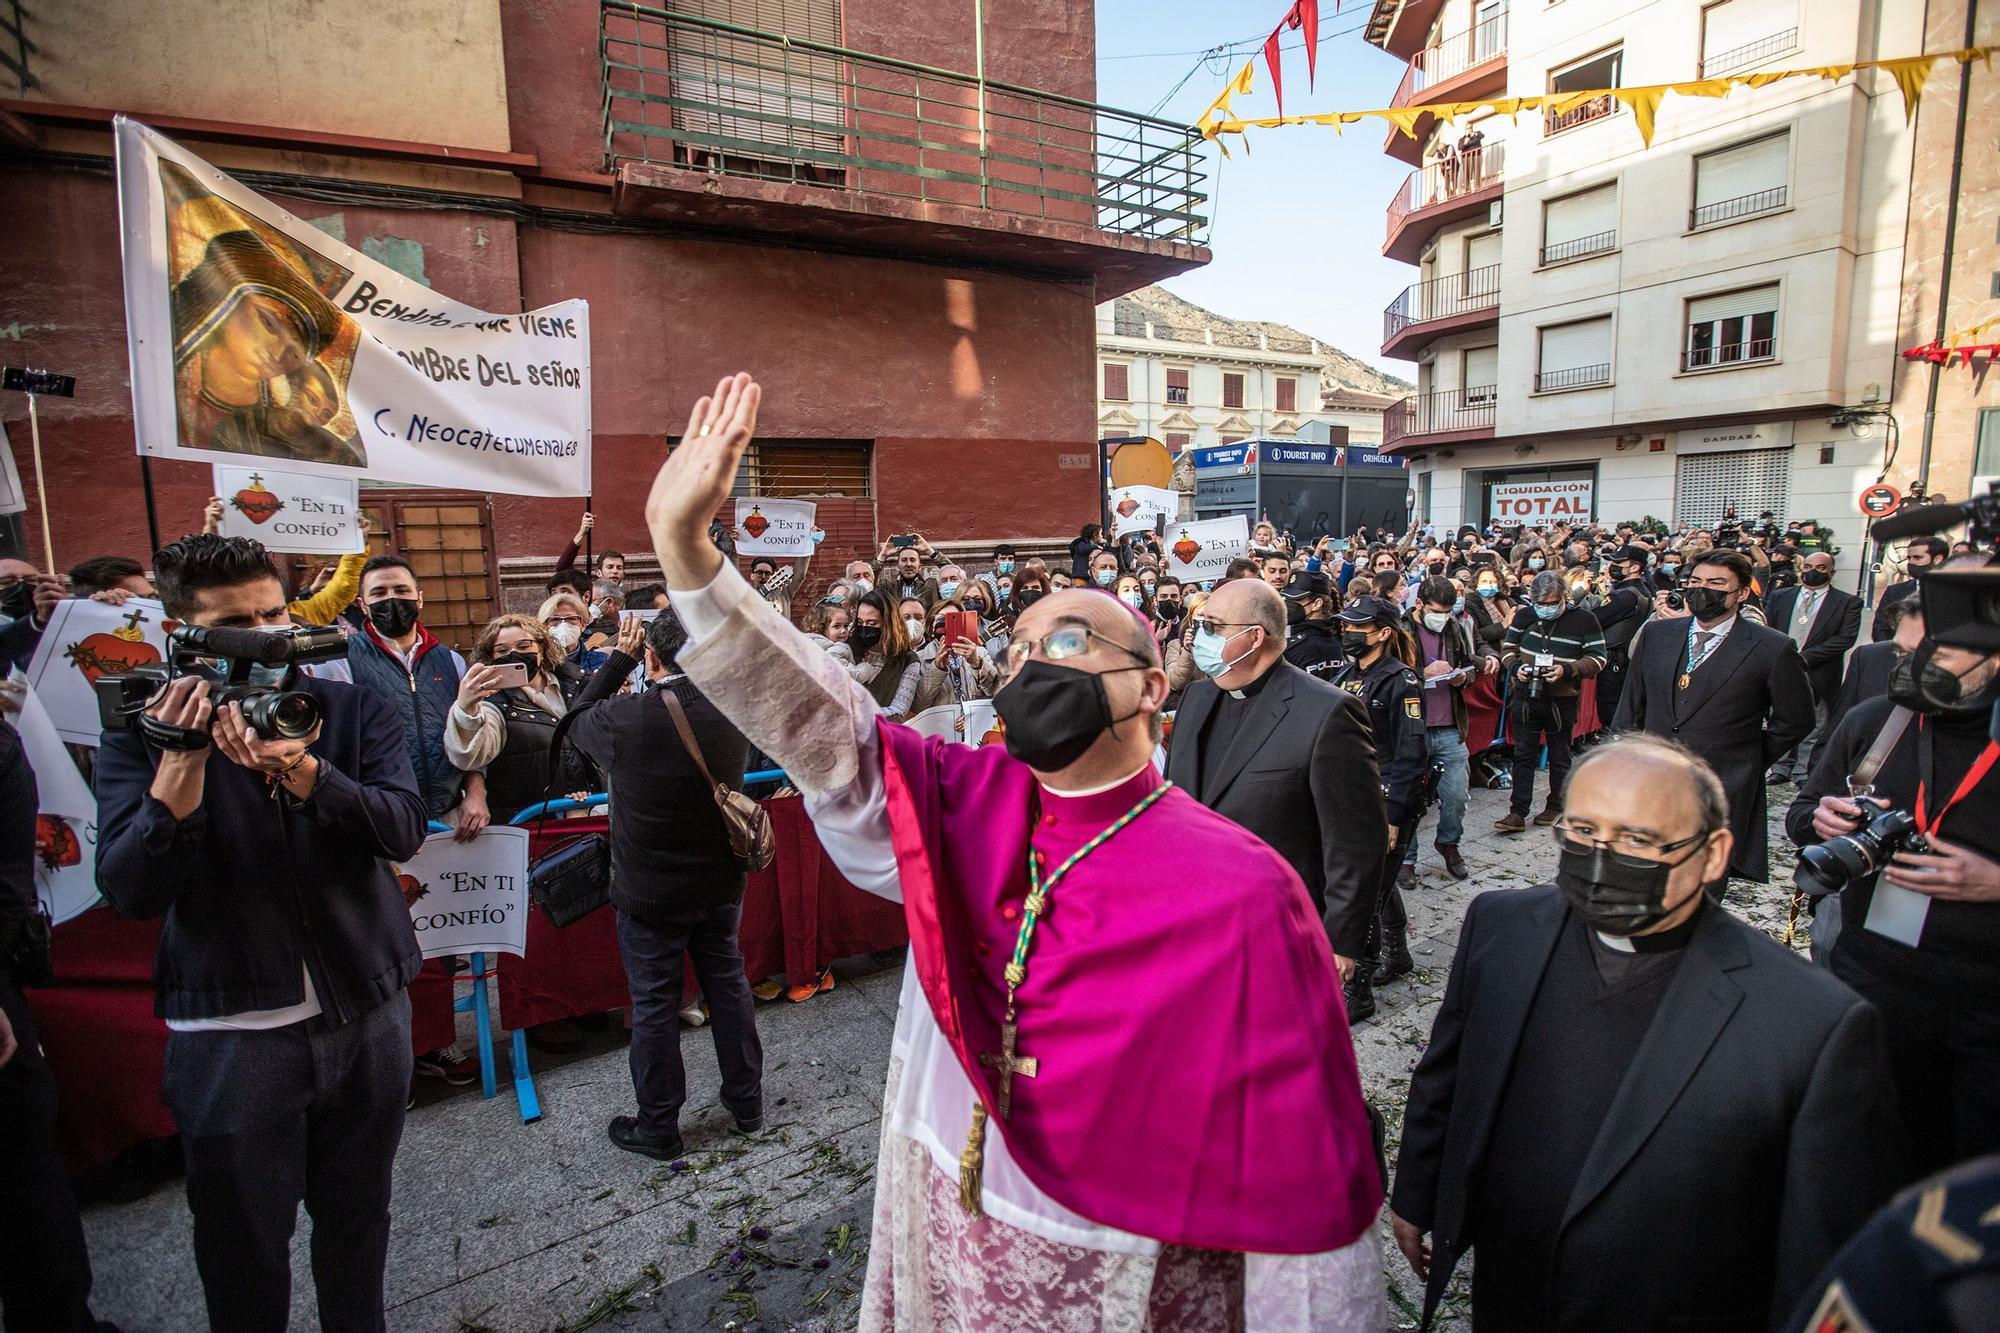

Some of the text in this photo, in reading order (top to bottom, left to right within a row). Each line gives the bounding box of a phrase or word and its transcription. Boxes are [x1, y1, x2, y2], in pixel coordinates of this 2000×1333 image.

[519, 315, 577, 339] VIENE
[396, 346, 581, 390] MBRE DEL SEÑOR
[374, 408, 396, 438] C.
[1703, 433, 1762, 443] DANDARA
[1283, 450, 1326, 461] TOURIST INFO
[1362, 454, 1393, 464] ORIHUELA
[1496, 483, 1590, 496] LIQUIDACIÓN
[329, 503, 345, 515] TI
[1162, 506, 1171, 514] TI
[1496, 496, 1589, 517] TOTAL
[795, 522, 805, 530] TI
[1229, 539, 1240, 548] TI
[494, 875, 515, 891] TI
